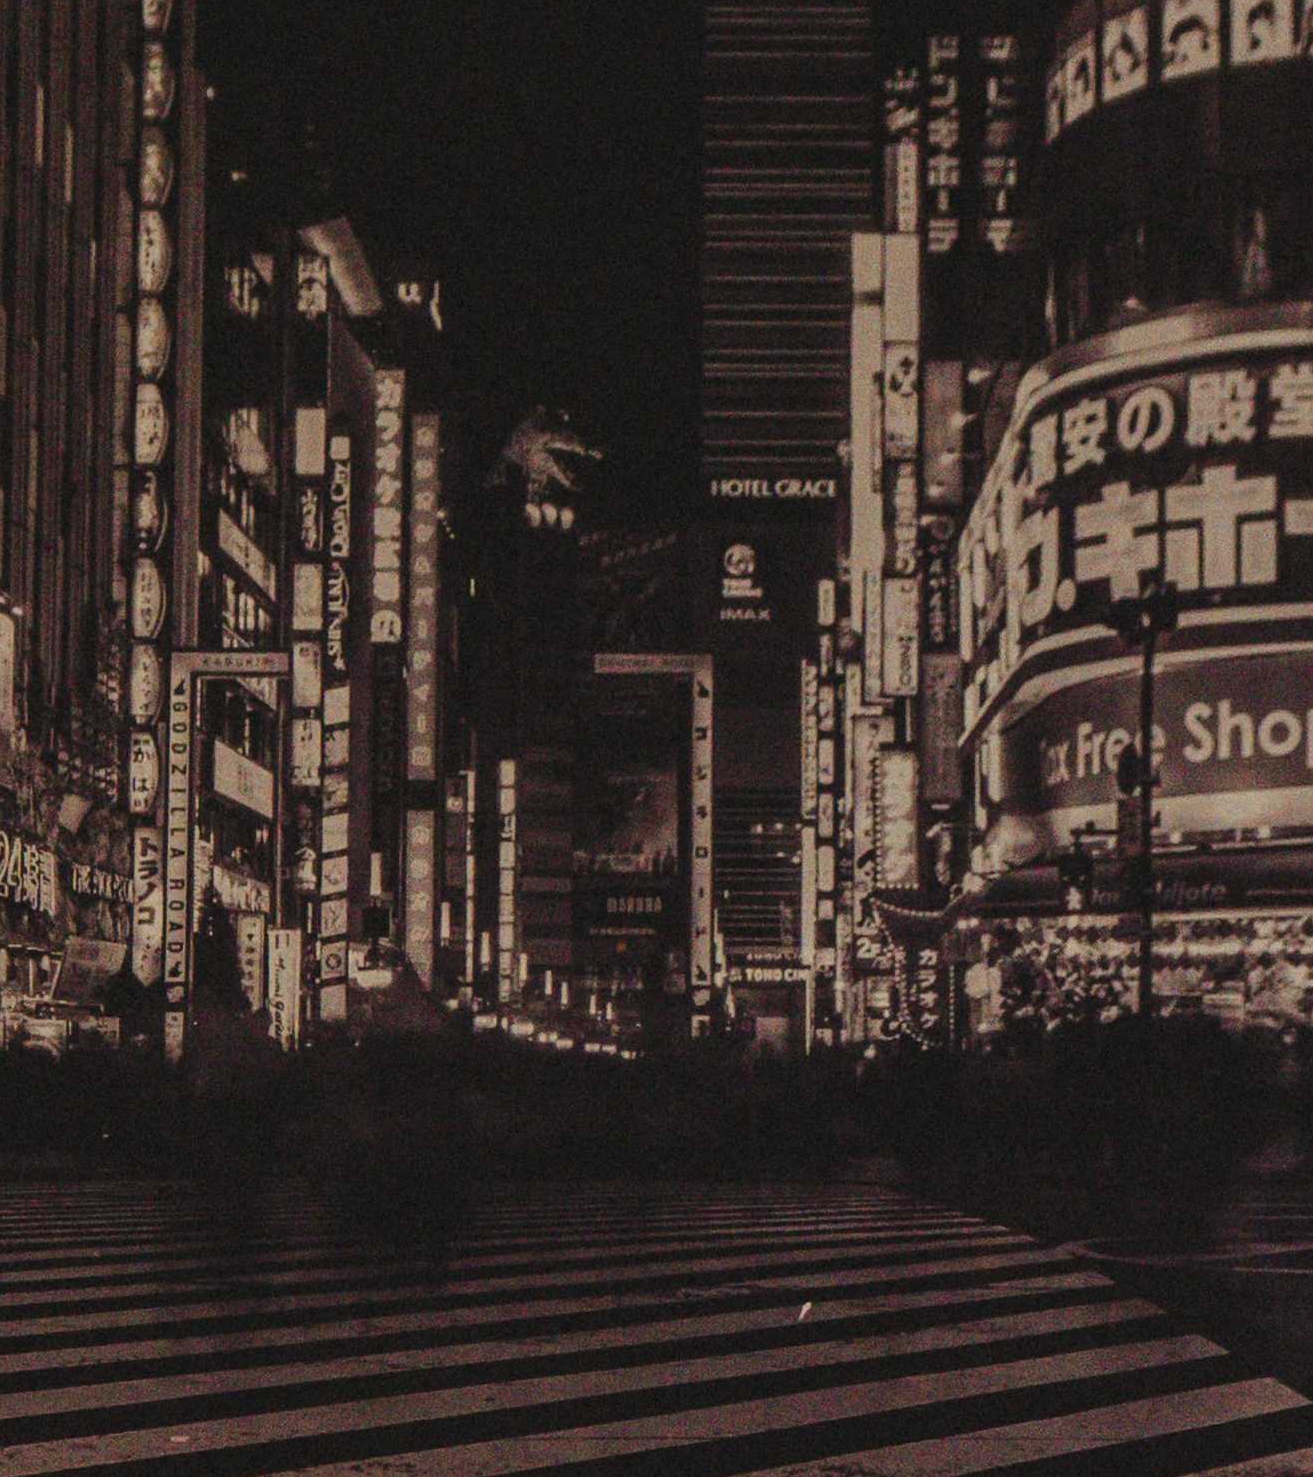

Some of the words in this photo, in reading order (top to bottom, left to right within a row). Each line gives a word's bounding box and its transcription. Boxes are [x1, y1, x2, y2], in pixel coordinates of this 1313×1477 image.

[710, 479, 772, 497] HOTEL
[170, 701, 189, 860] GODZILLA
[168, 877, 186, 953] ROAD
